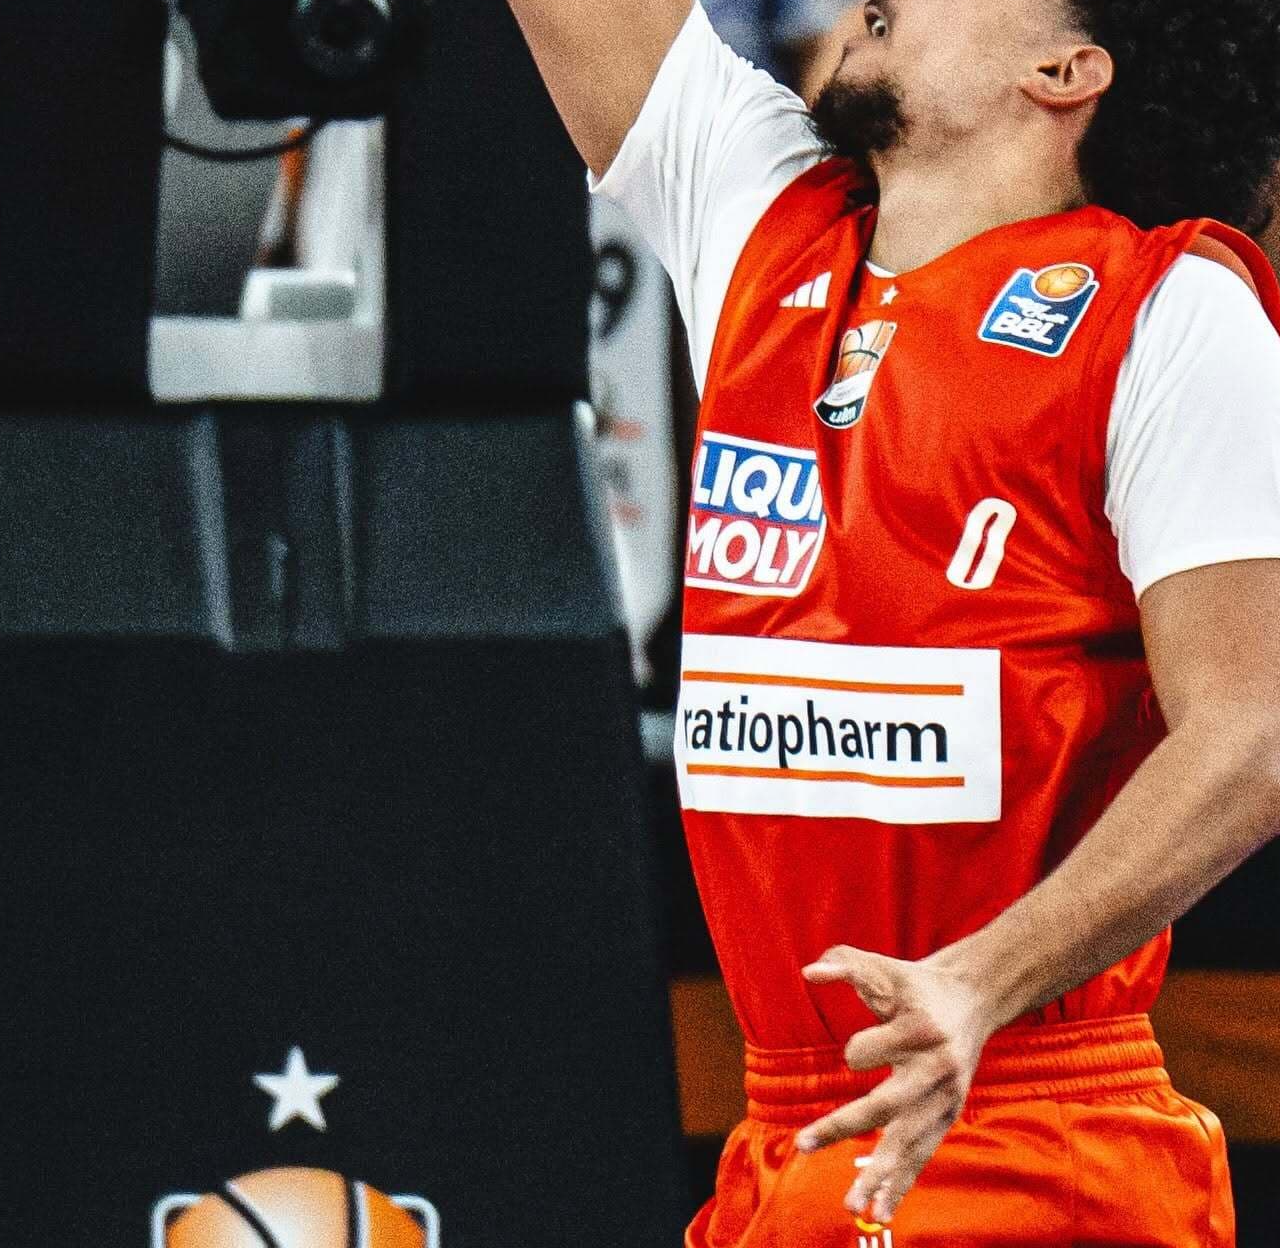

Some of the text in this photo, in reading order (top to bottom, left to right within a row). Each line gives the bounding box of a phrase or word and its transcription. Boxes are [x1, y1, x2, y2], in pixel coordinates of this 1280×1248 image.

[989, 311, 1055, 346] BBL
[687, 514, 819, 584] MOLY
[946, 496, 1018, 590] 0
[683, 694, 949, 769] ratiopharm
